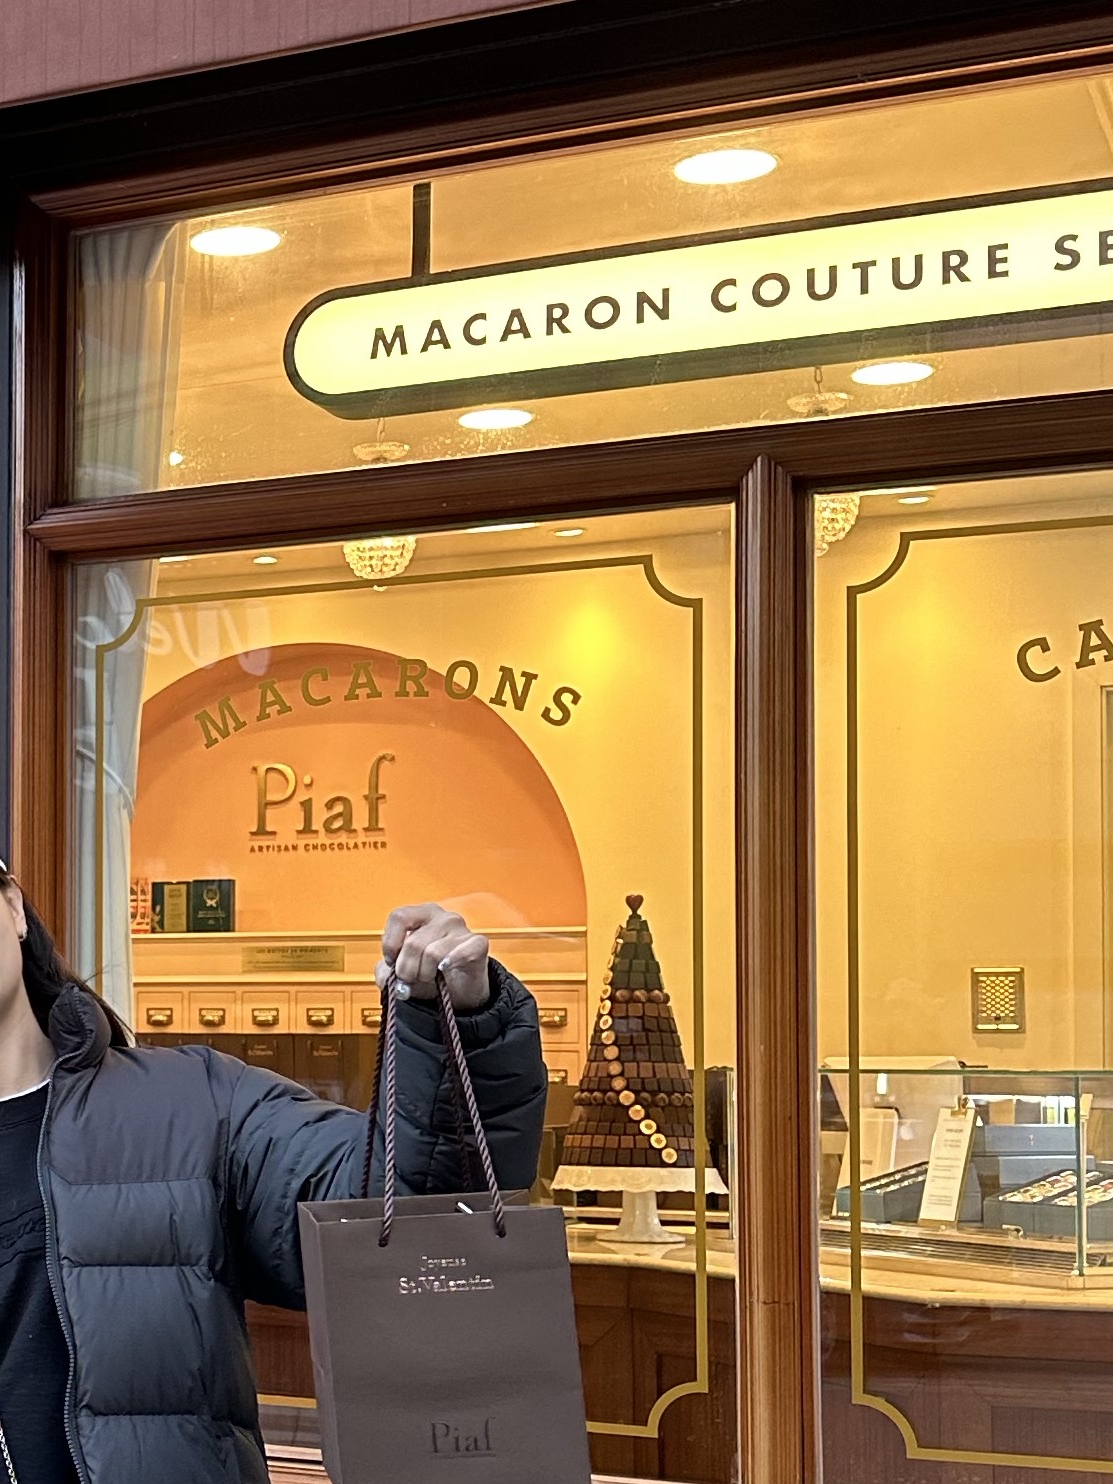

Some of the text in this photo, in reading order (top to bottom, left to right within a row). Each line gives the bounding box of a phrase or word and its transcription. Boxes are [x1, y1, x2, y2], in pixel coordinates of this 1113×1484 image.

[370, 288, 670, 359] MACARON
[711, 243, 1009, 313] COUTURE
[194, 659, 582, 750] MACARONS
[249, 753, 395, 836] Piaf
[249, 841, 387, 853] ARTISAN CHOCOLATIER
